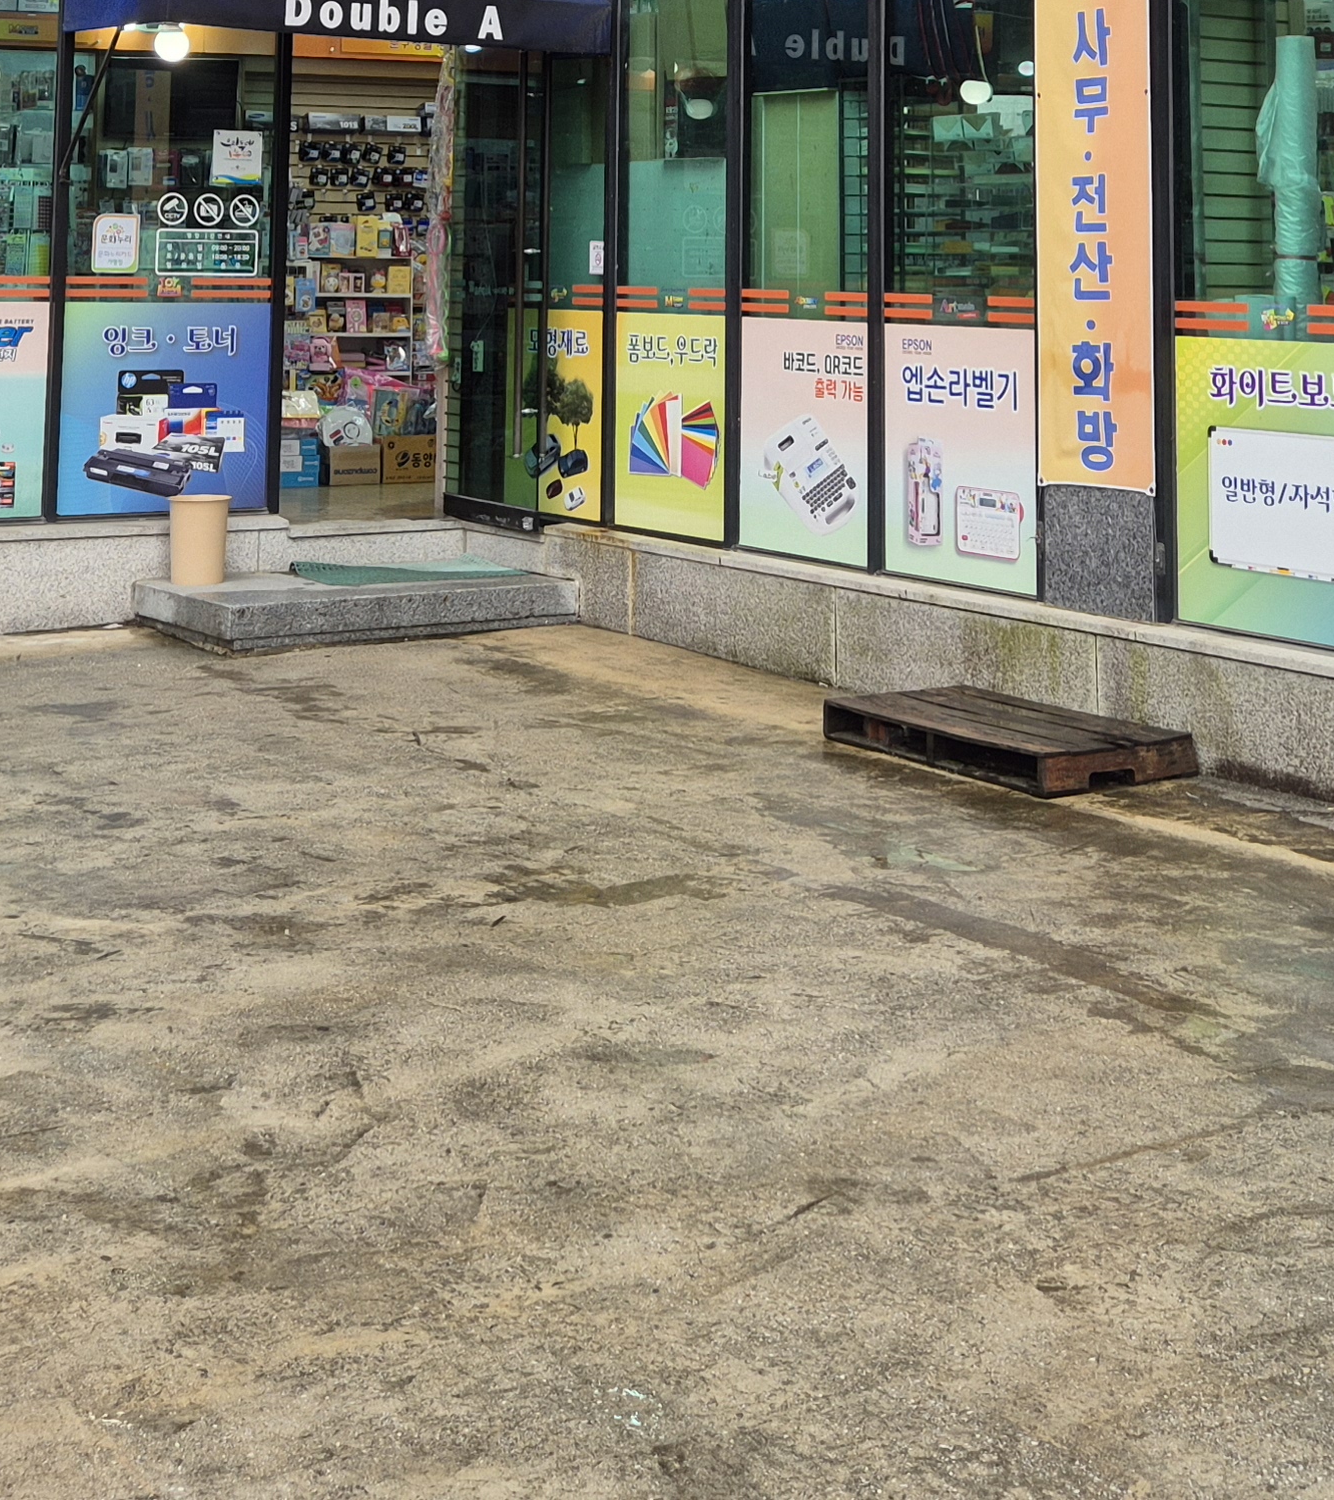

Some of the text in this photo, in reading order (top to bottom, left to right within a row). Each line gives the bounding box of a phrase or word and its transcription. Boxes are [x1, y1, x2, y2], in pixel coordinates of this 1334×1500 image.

[477, 5, 504, 41] A
[102, 325, 237, 357] 잉크 토너
[836, 334, 864, 346] EPSON
[902, 338, 932, 351] EPSON
[824, 355, 865, 378] QR코드
[814, 378, 864, 402] 출력 가능
[901, 363, 1019, 413] 엡손라벨기
[181, 444, 220, 457] 105L
[411, 452, 436, 469] 동양
[191, 461, 217, 473] 105L
